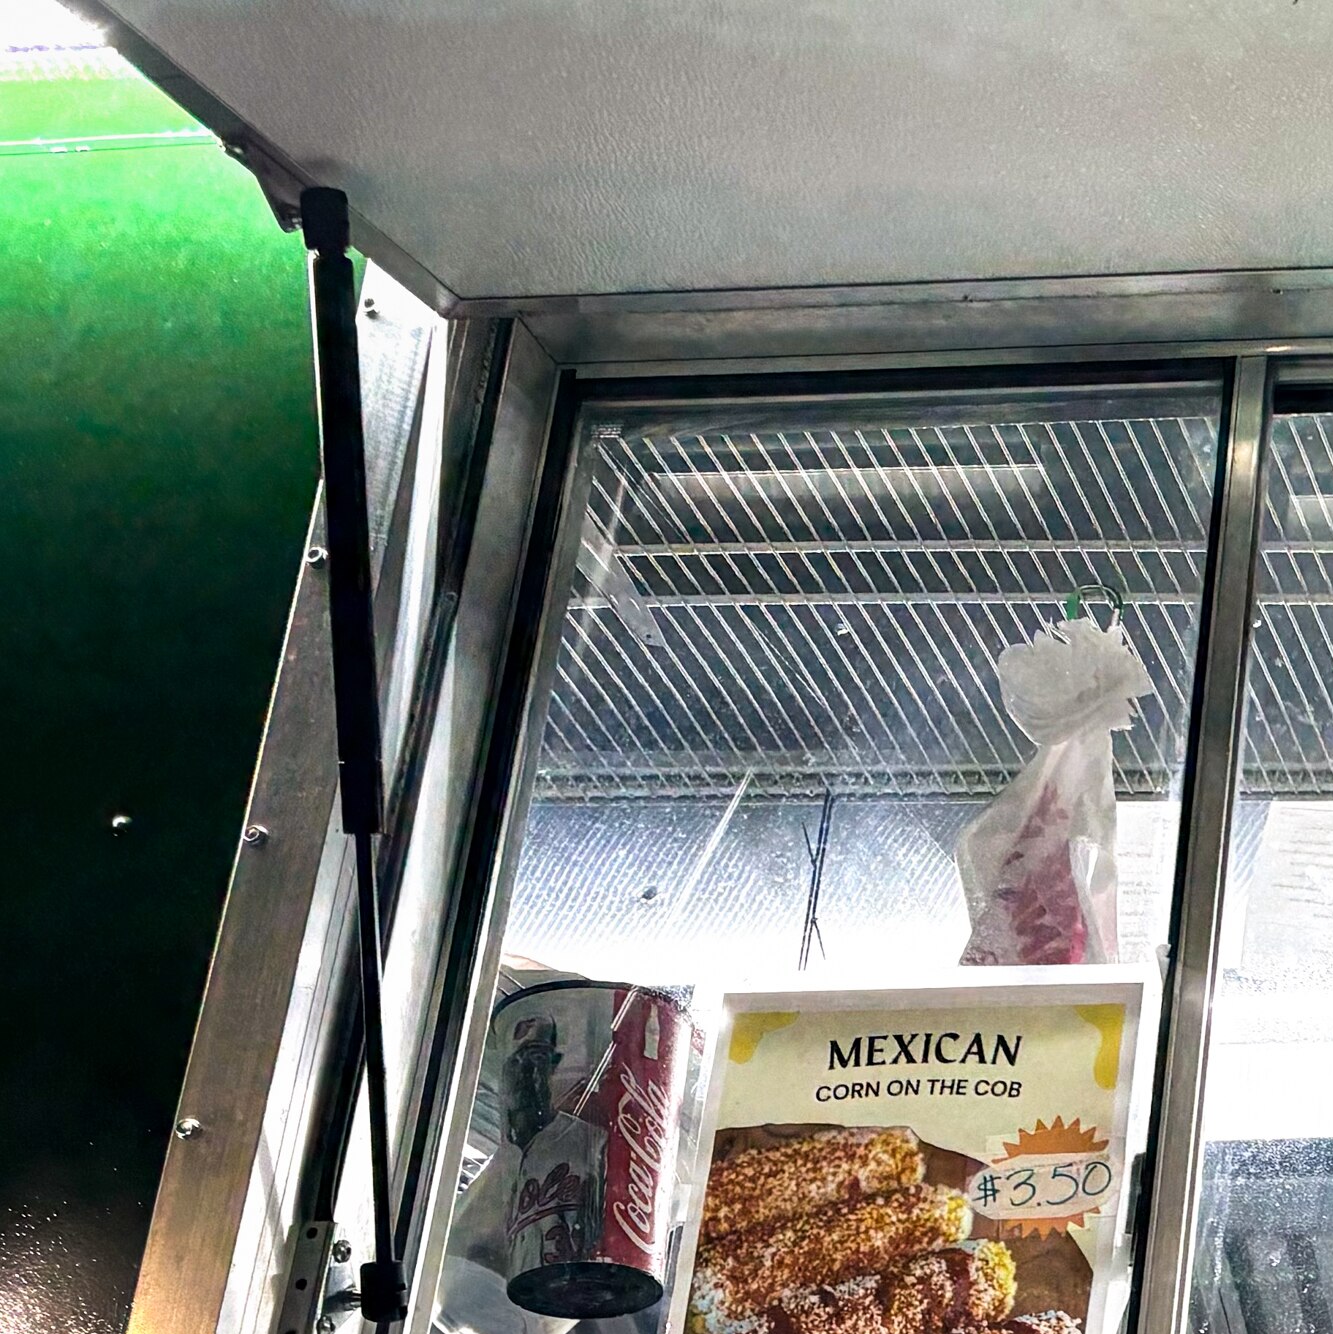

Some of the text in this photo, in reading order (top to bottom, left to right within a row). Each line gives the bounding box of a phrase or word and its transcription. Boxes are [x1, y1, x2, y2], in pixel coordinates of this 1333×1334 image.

[829, 1033, 1022, 1070] MEXICAN
[816, 1079, 1022, 1102] CORN ON THE COB
[612, 1062, 670, 1256] Coca-Cola
[974, 1160, 1113, 1207] $3.50
